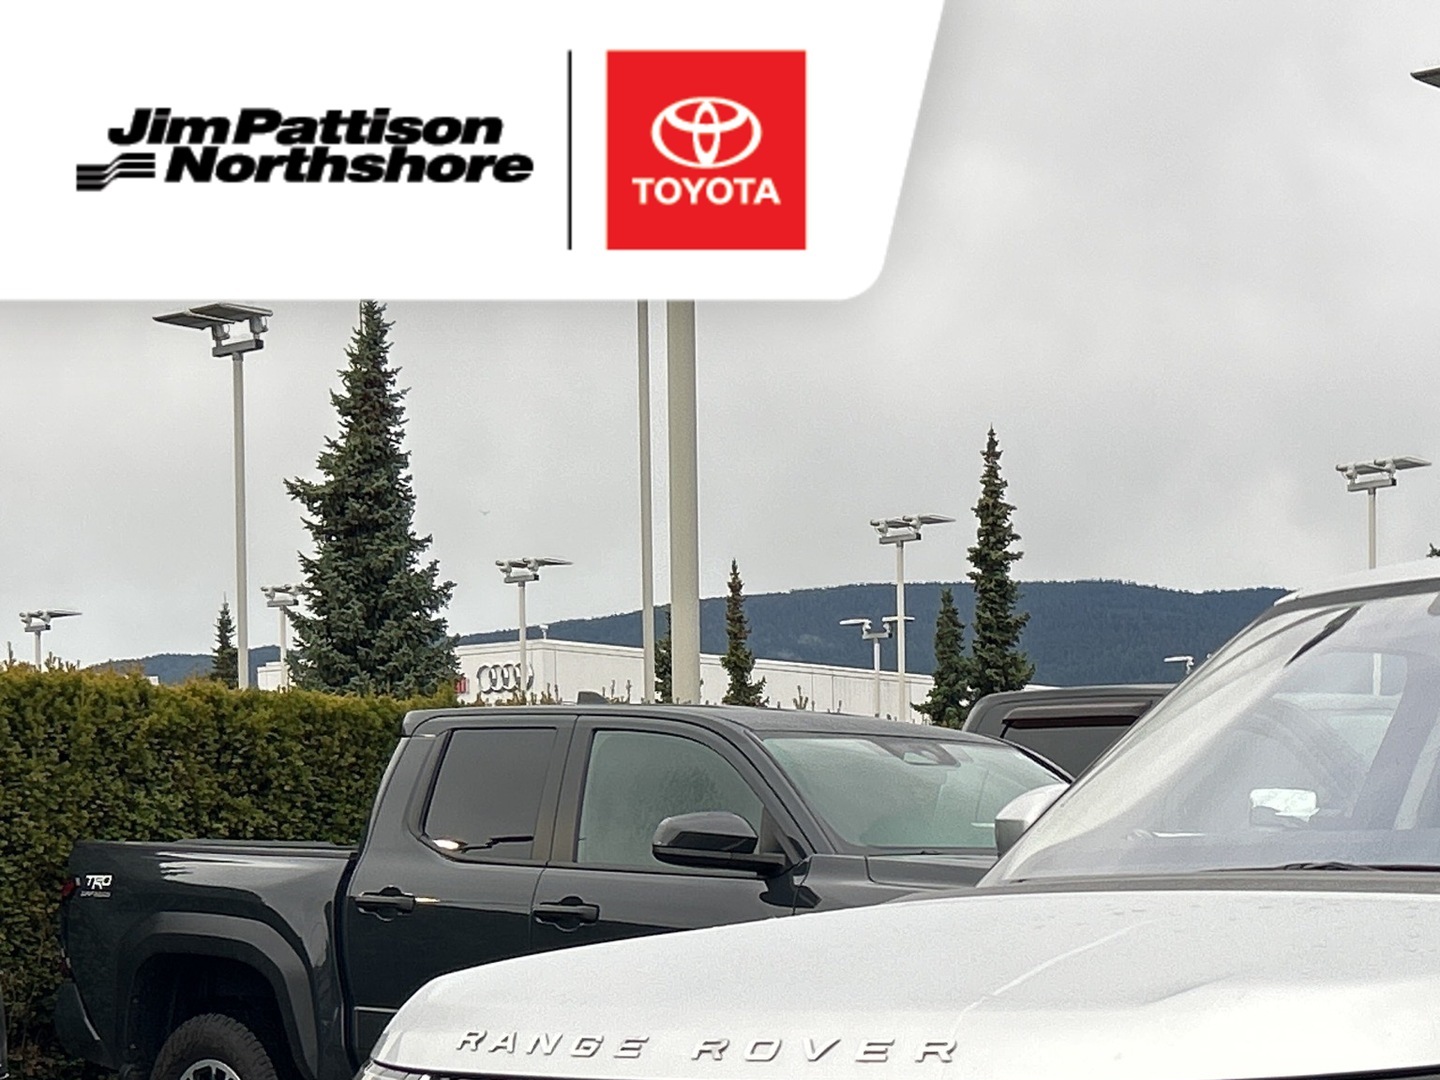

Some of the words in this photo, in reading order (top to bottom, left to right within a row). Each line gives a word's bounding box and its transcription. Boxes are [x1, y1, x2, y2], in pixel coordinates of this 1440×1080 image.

[85, 874, 113, 890] TRD
[456, 1030, 650, 1059] RANGE
[691, 1037, 958, 1063] ROVER
